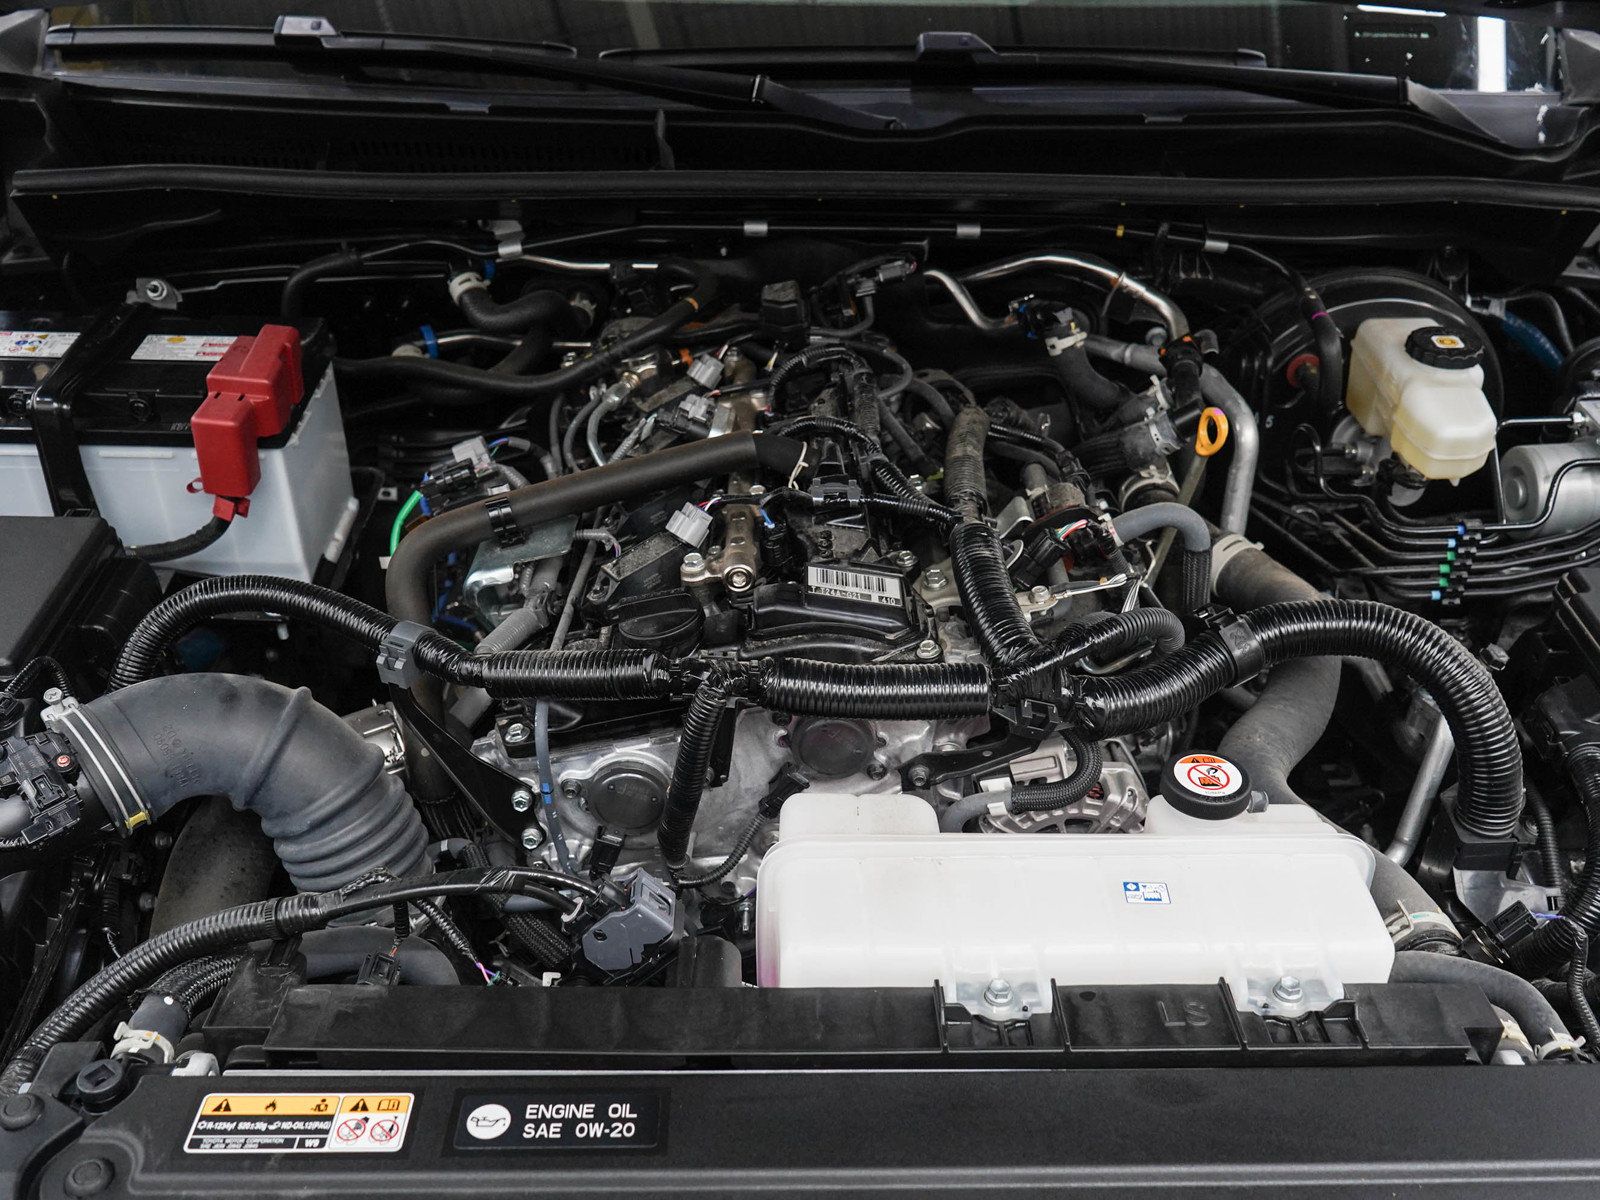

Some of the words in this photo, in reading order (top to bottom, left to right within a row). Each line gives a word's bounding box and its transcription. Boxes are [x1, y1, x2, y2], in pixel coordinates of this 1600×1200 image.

[1158, 1000, 1211, 1027] LS
[525, 1103, 596, 1119] ENGINE
[608, 1103, 638, 1119] OIL
[522, 1122, 563, 1138] SAE
[574, 1122, 636, 1138] 0W-20
